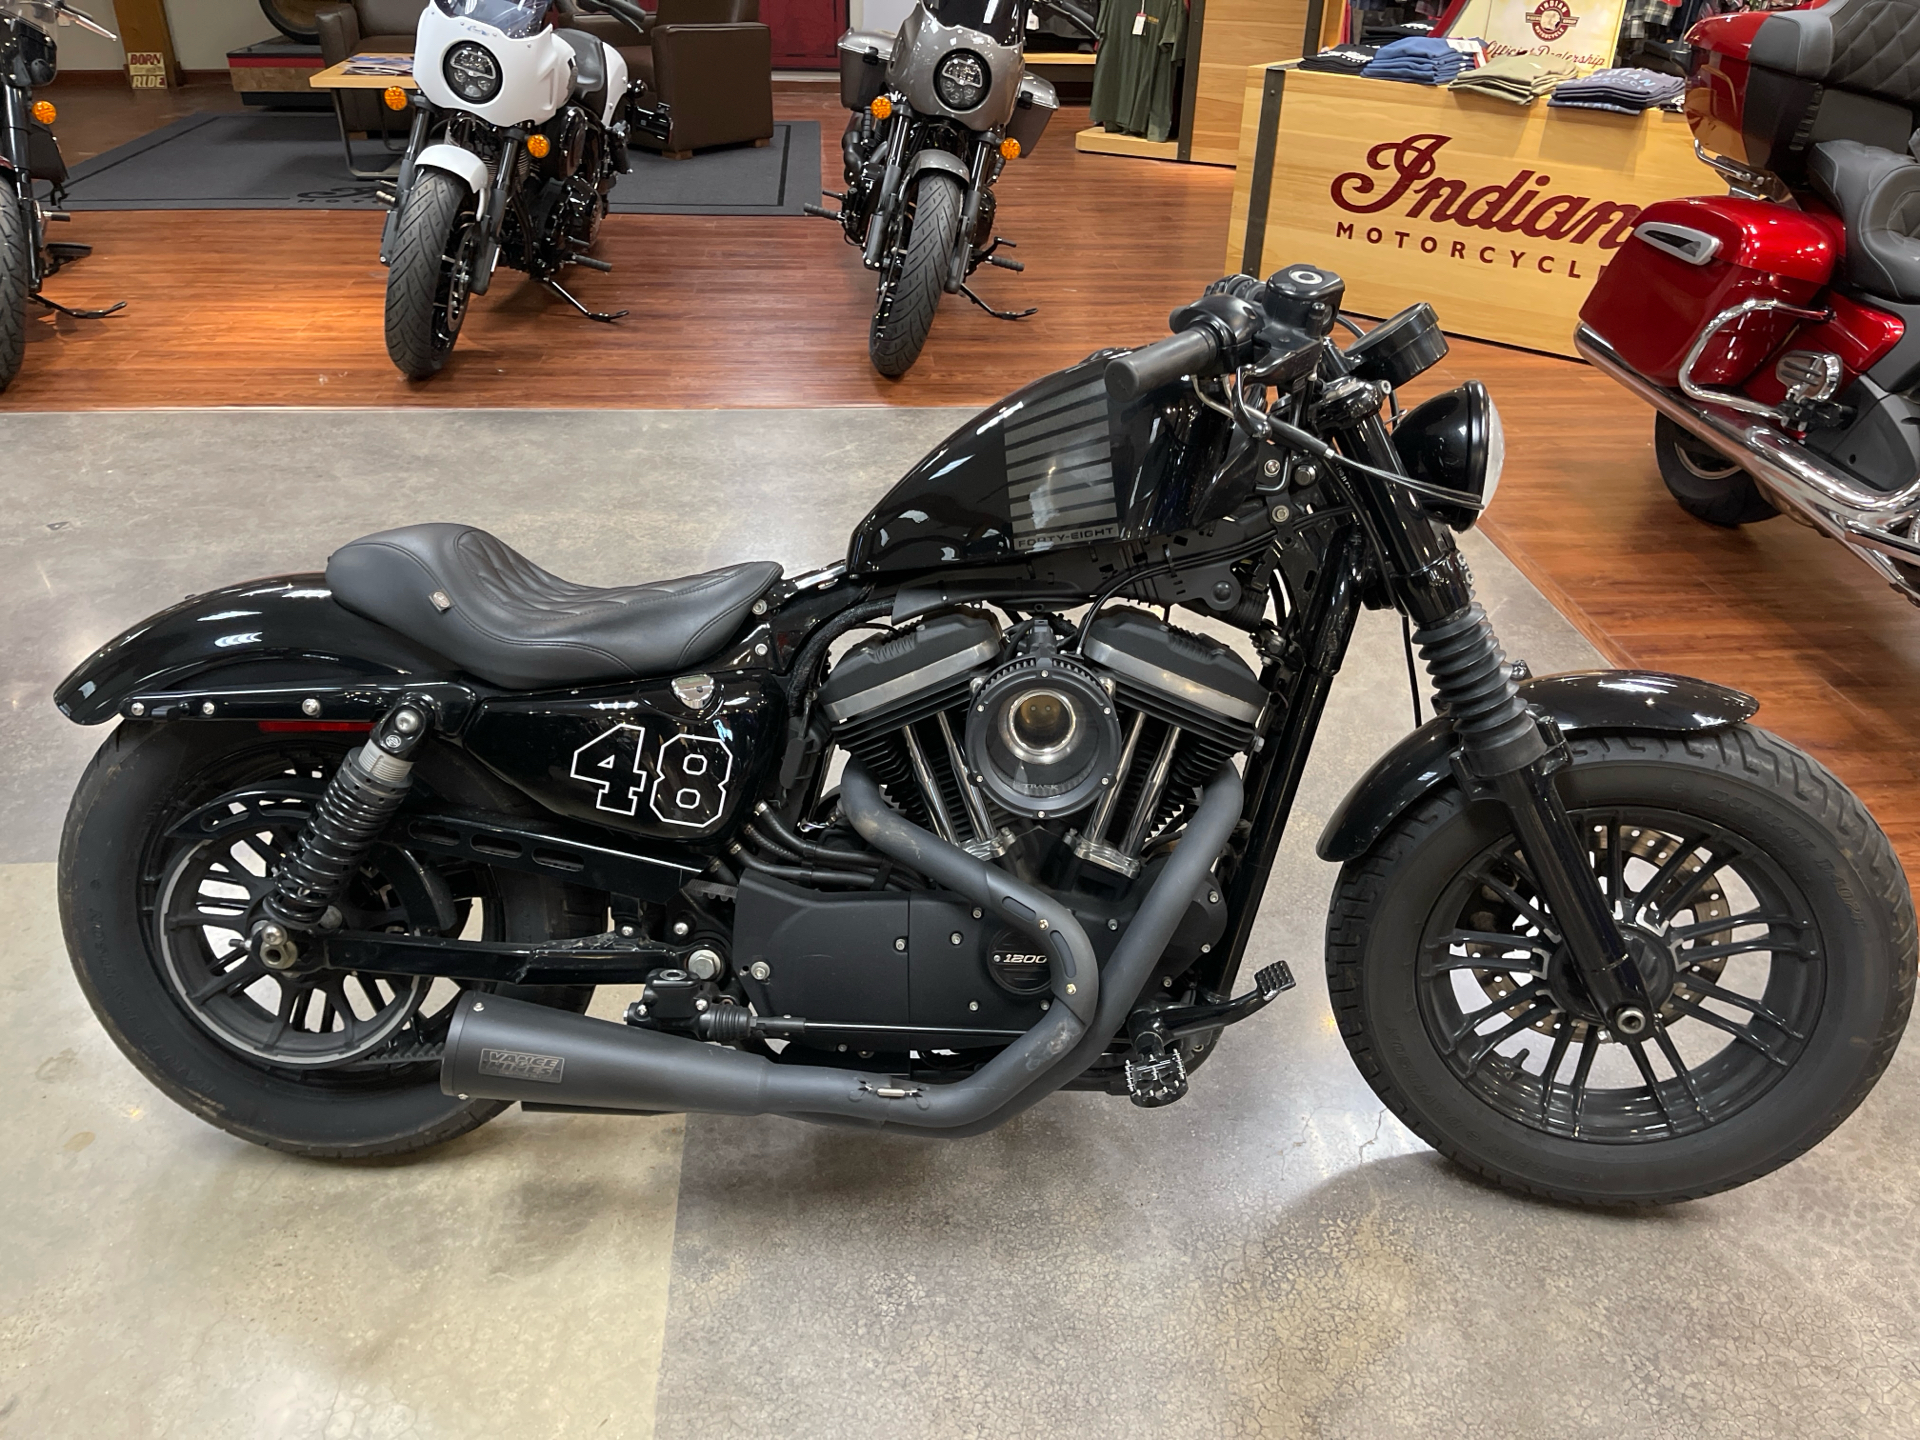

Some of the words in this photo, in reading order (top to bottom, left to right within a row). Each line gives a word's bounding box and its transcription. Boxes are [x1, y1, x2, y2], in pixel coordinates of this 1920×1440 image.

[1487, 40, 1534, 58] Officil
[130, 54, 161, 65] BORN
[132, 75, 165, 88] RIDE
[1331, 134, 1641, 250] Indian
[1336, 222, 1608, 283] MOTORCYCL
[1018, 527, 1114, 548] FORTY-EIGHT
[569, 723, 733, 828] 48
[1003, 953, 1048, 964] 1200
[490, 1051, 560, 1069] VANCE
